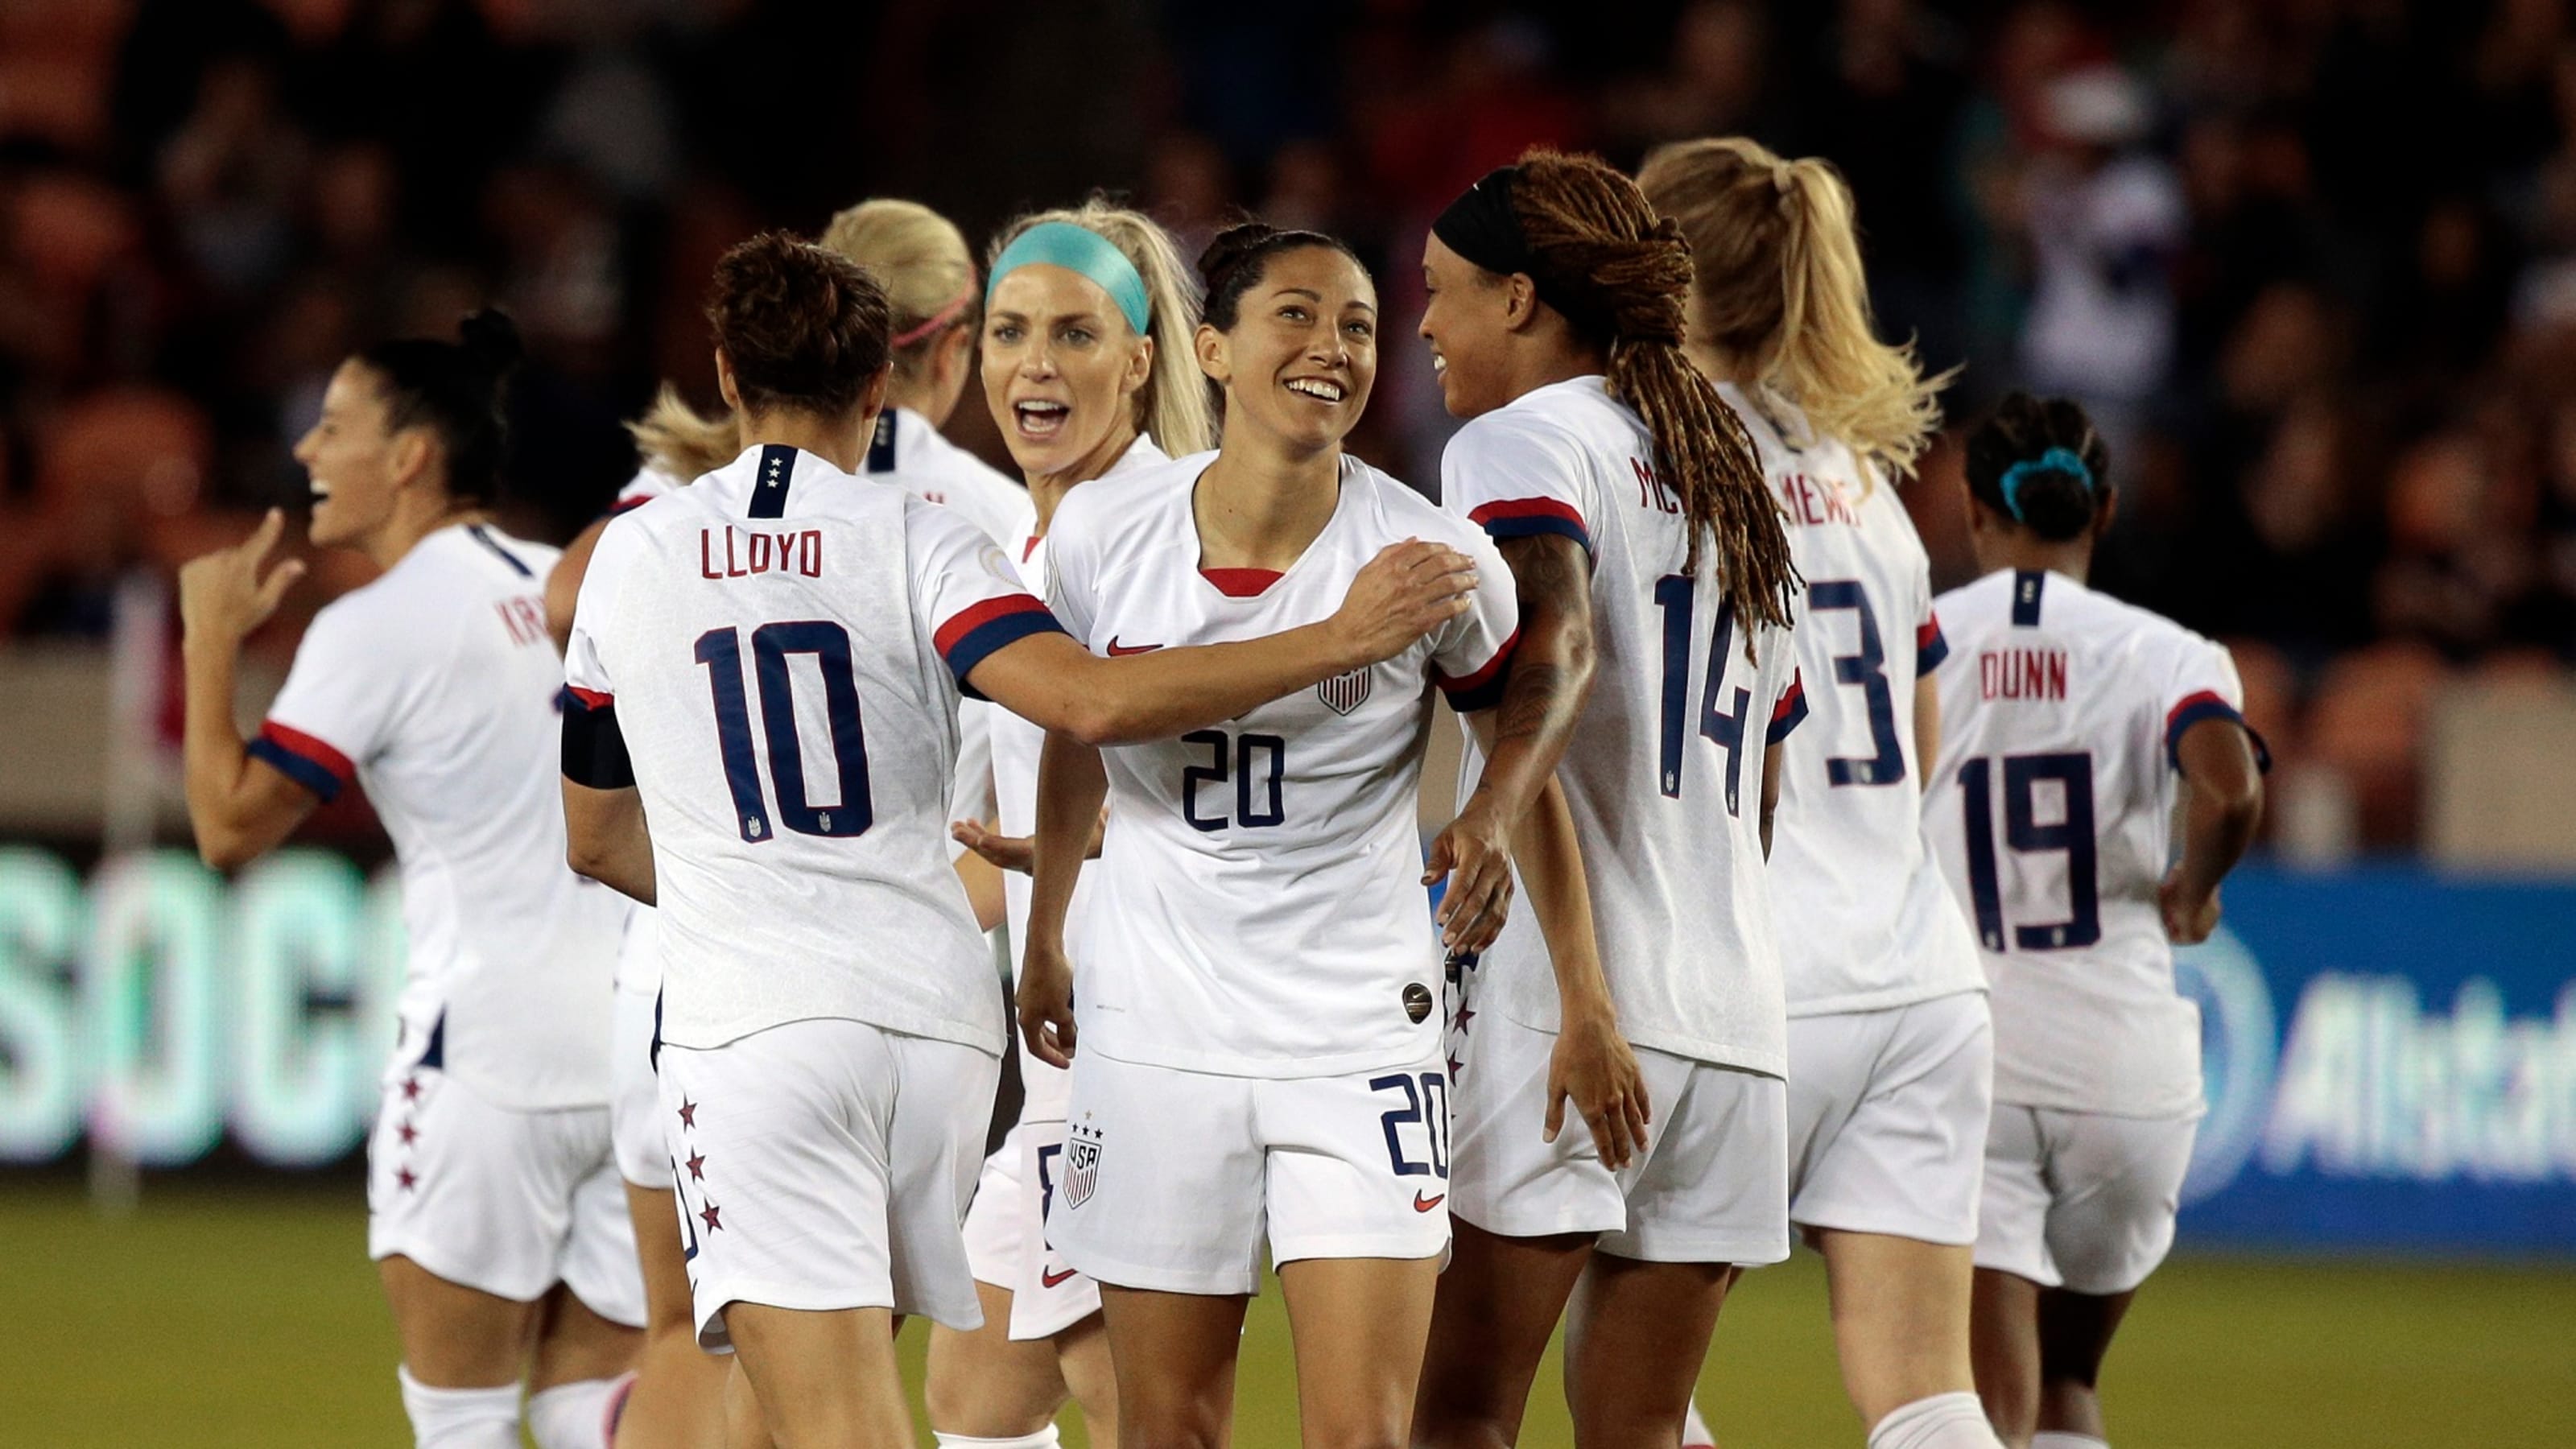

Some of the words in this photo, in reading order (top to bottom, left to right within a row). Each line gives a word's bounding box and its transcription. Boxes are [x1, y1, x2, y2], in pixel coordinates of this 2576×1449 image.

[701, 526, 821, 580] LLOYD
[493, 594, 547, 647] KR
[1654, 574, 1751, 819] 14
[1809, 580, 1905, 787] 3
[1980, 648, 2066, 702] DUNN
[694, 621, 873, 844] 10
[1182, 730, 1285, 832] 20
[1958, 752, 2100, 953] 19
[1070, 1142, 1097, 1170] USA
[1368, 1072, 1449, 1179] 20
